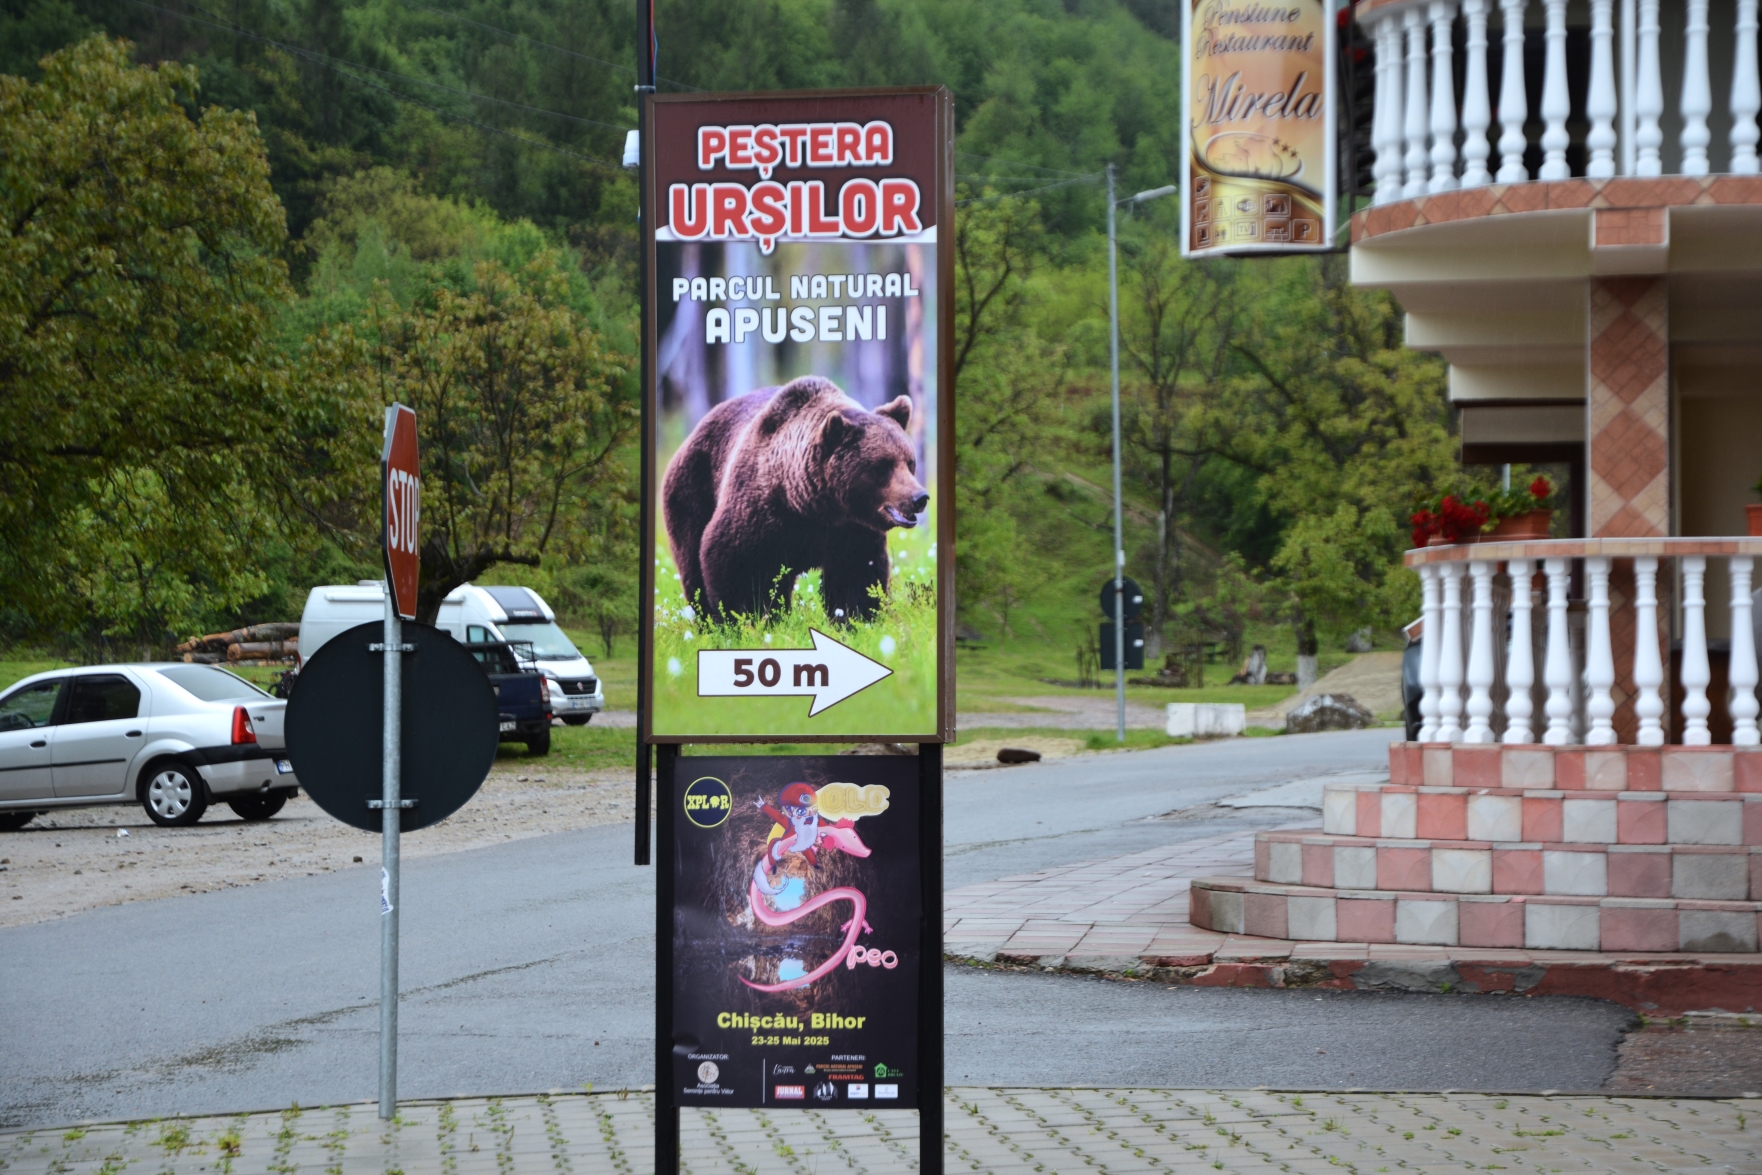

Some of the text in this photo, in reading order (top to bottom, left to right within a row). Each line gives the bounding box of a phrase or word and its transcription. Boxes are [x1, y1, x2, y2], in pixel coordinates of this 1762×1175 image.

[1196, 27, 1314, 59] Restaurant
[1191, 70, 1324, 128] Mirela
[699, 121, 892, 178] PEȘTERA
[670, 179, 923, 254] URȘILOR
[672, 273, 920, 301] PARCUL NATURAL
[706, 304, 888, 344] APUSENI
[390, 467, 419, 555] STOP
[733, 657, 830, 688] 50 m
[717, 1012, 866, 1033] Chișcău, Bihor
[751, 1036, 830, 1046] 23-25 Mai 2025
[777, 1086, 803, 1095] JURNAL
